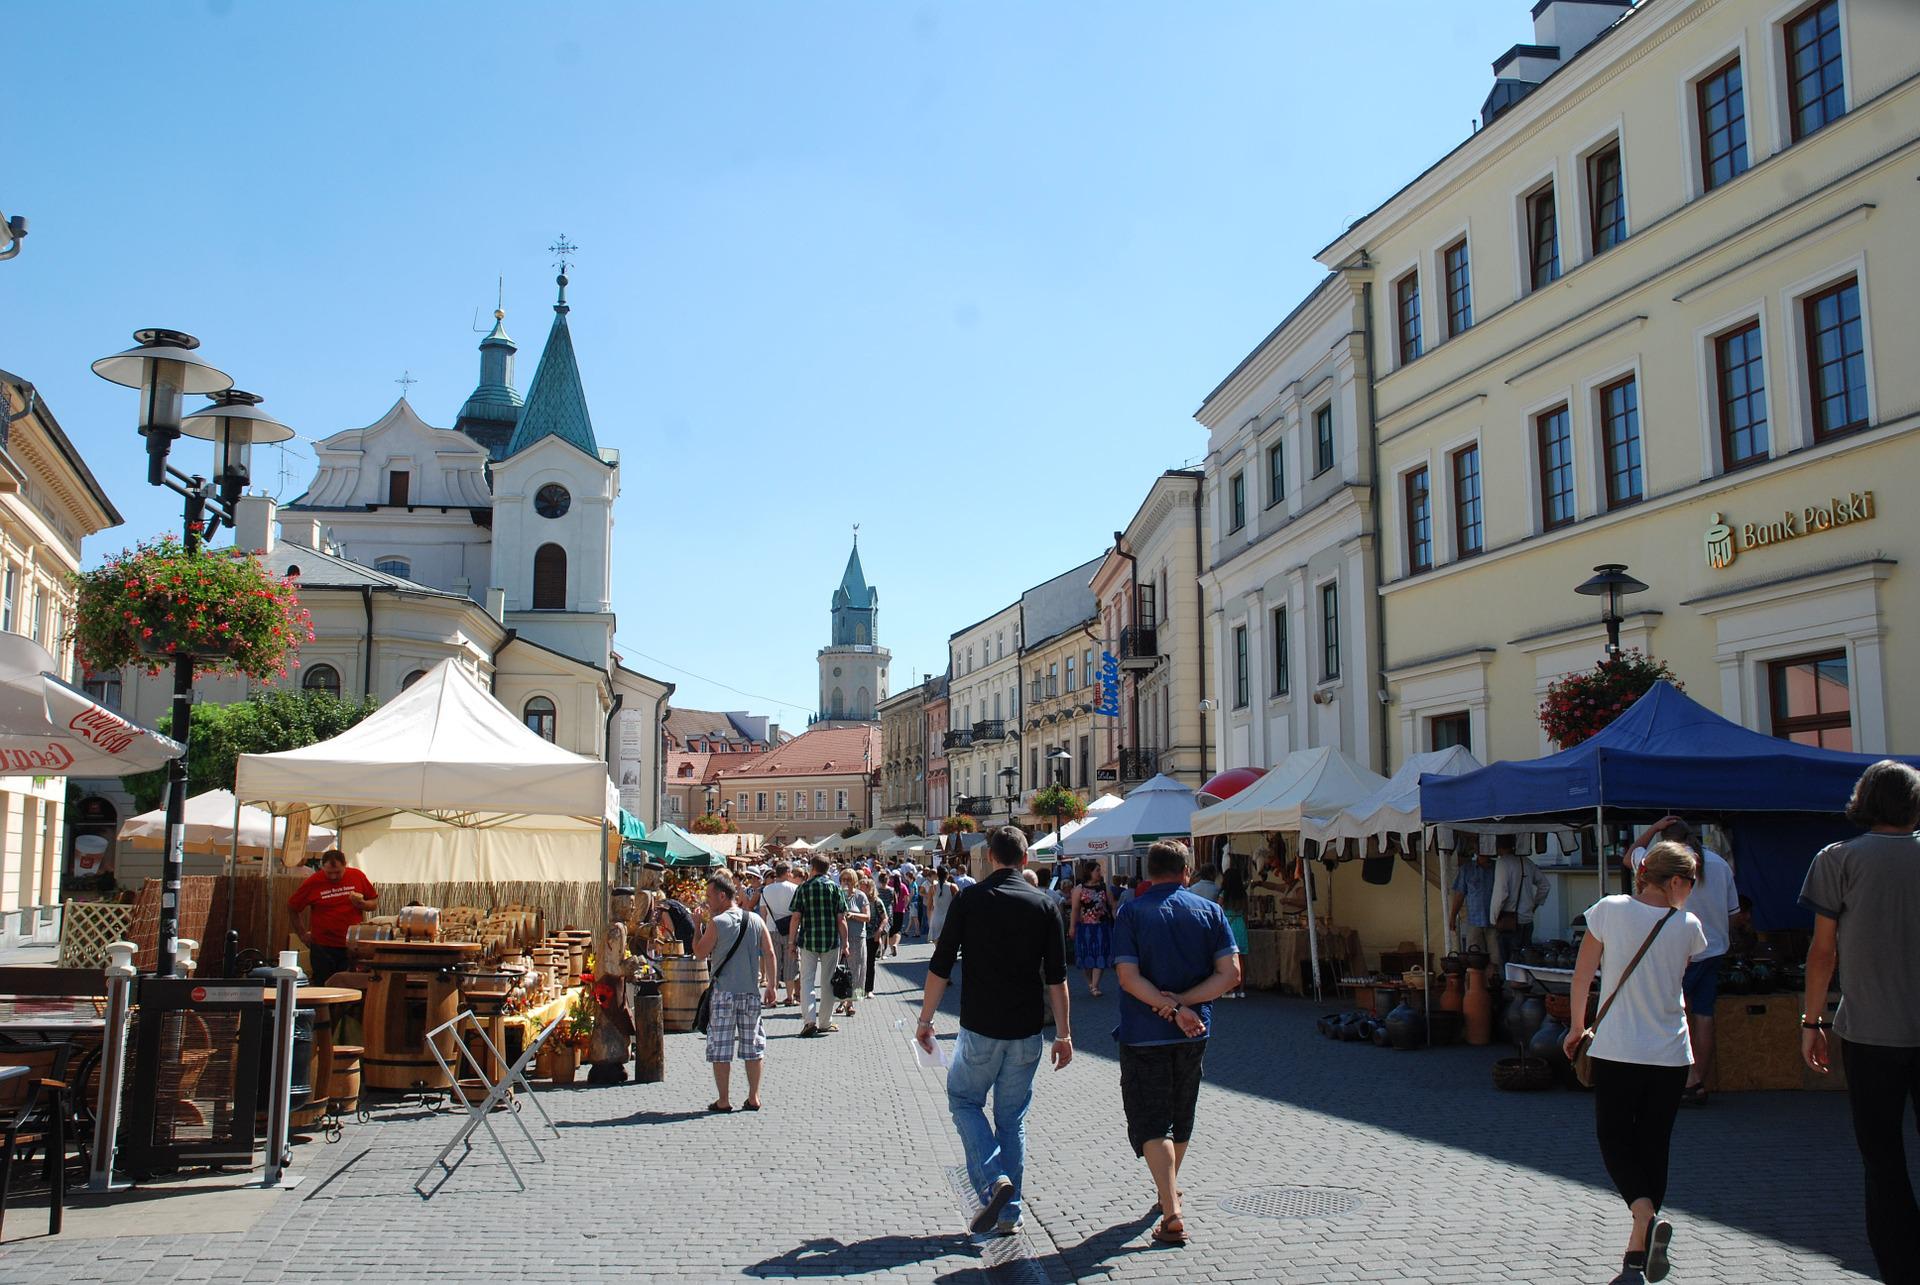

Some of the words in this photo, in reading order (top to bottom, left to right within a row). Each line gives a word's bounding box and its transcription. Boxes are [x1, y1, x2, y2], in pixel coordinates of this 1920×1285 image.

[1742, 512, 1796, 549] Bank
[1802, 492, 1871, 534] Polski
[1095, 651, 1119, 718] kurier
[1087, 840, 1109, 850] export
